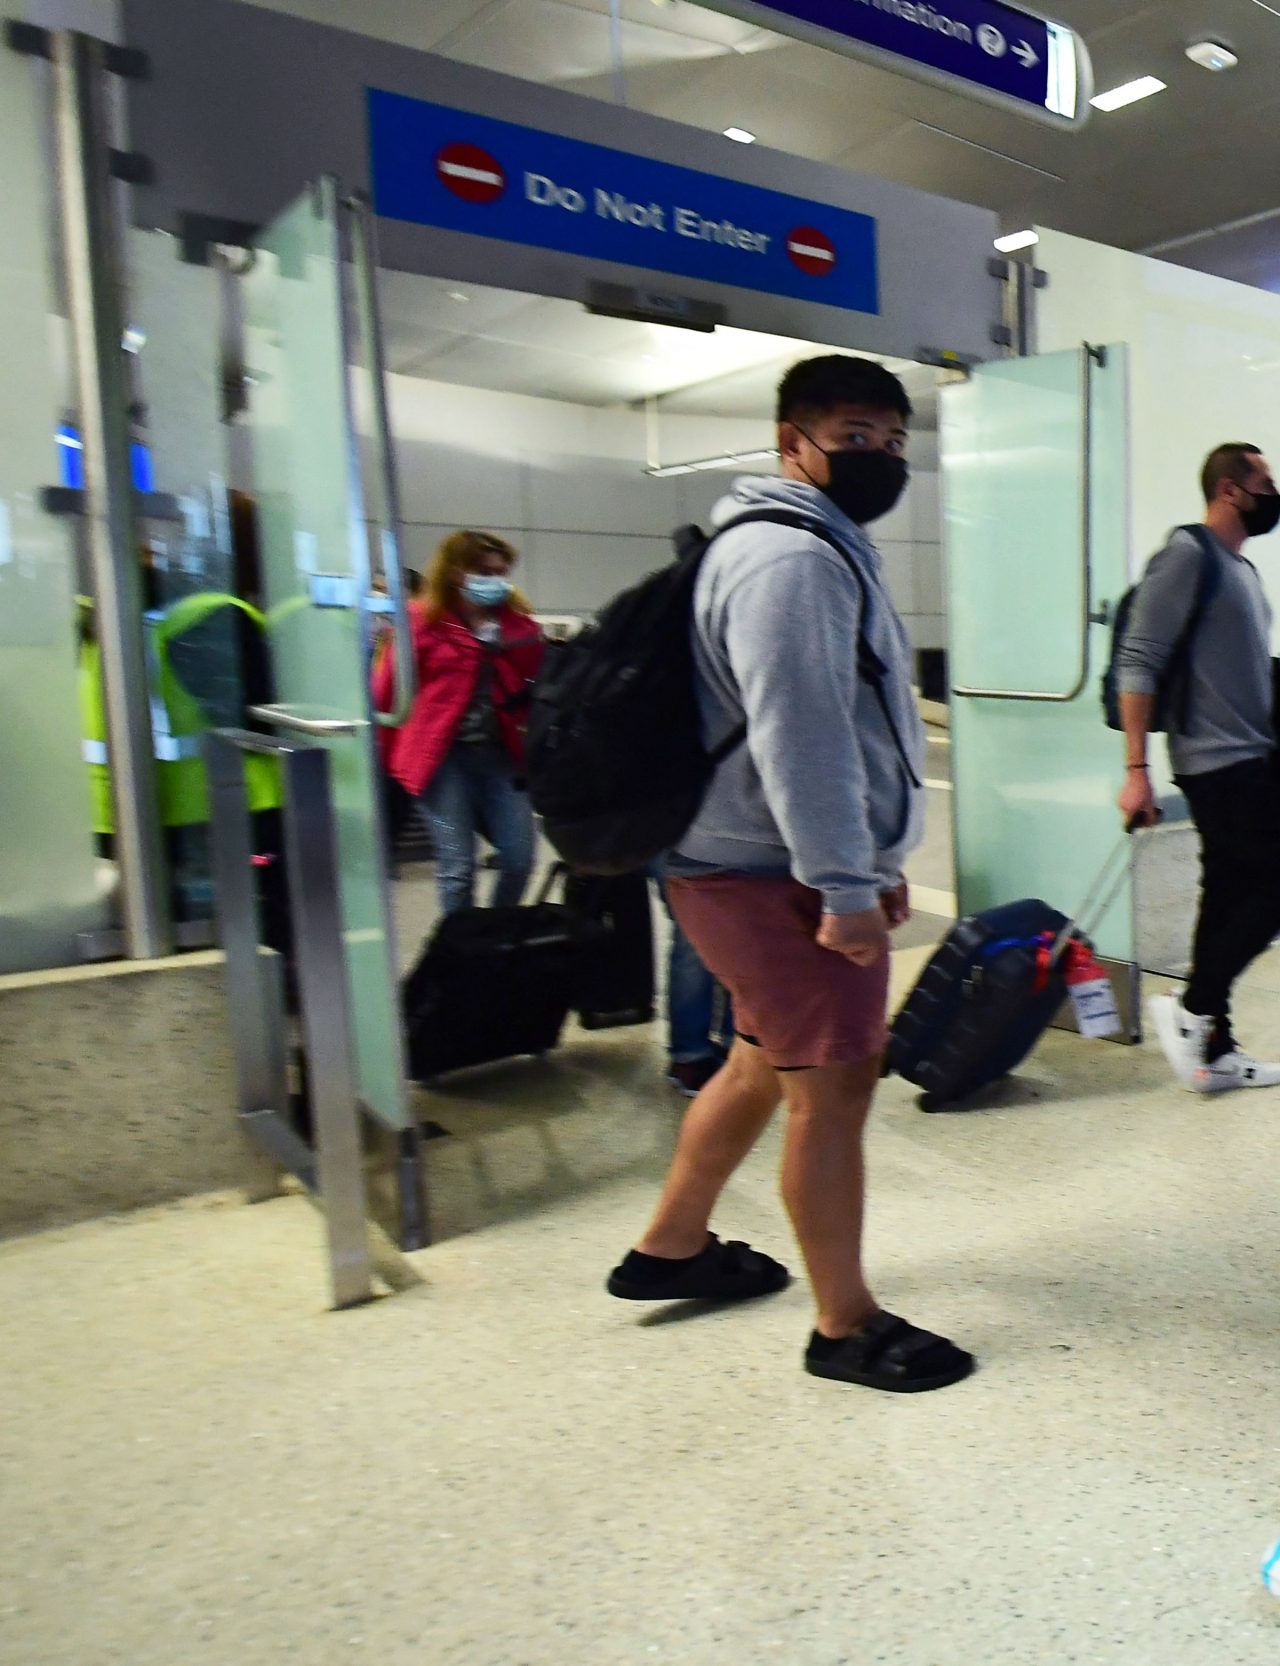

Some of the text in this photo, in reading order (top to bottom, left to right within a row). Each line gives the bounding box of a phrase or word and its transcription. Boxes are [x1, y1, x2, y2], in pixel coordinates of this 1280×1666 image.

[523, 170, 771, 254] Do Not Enter
